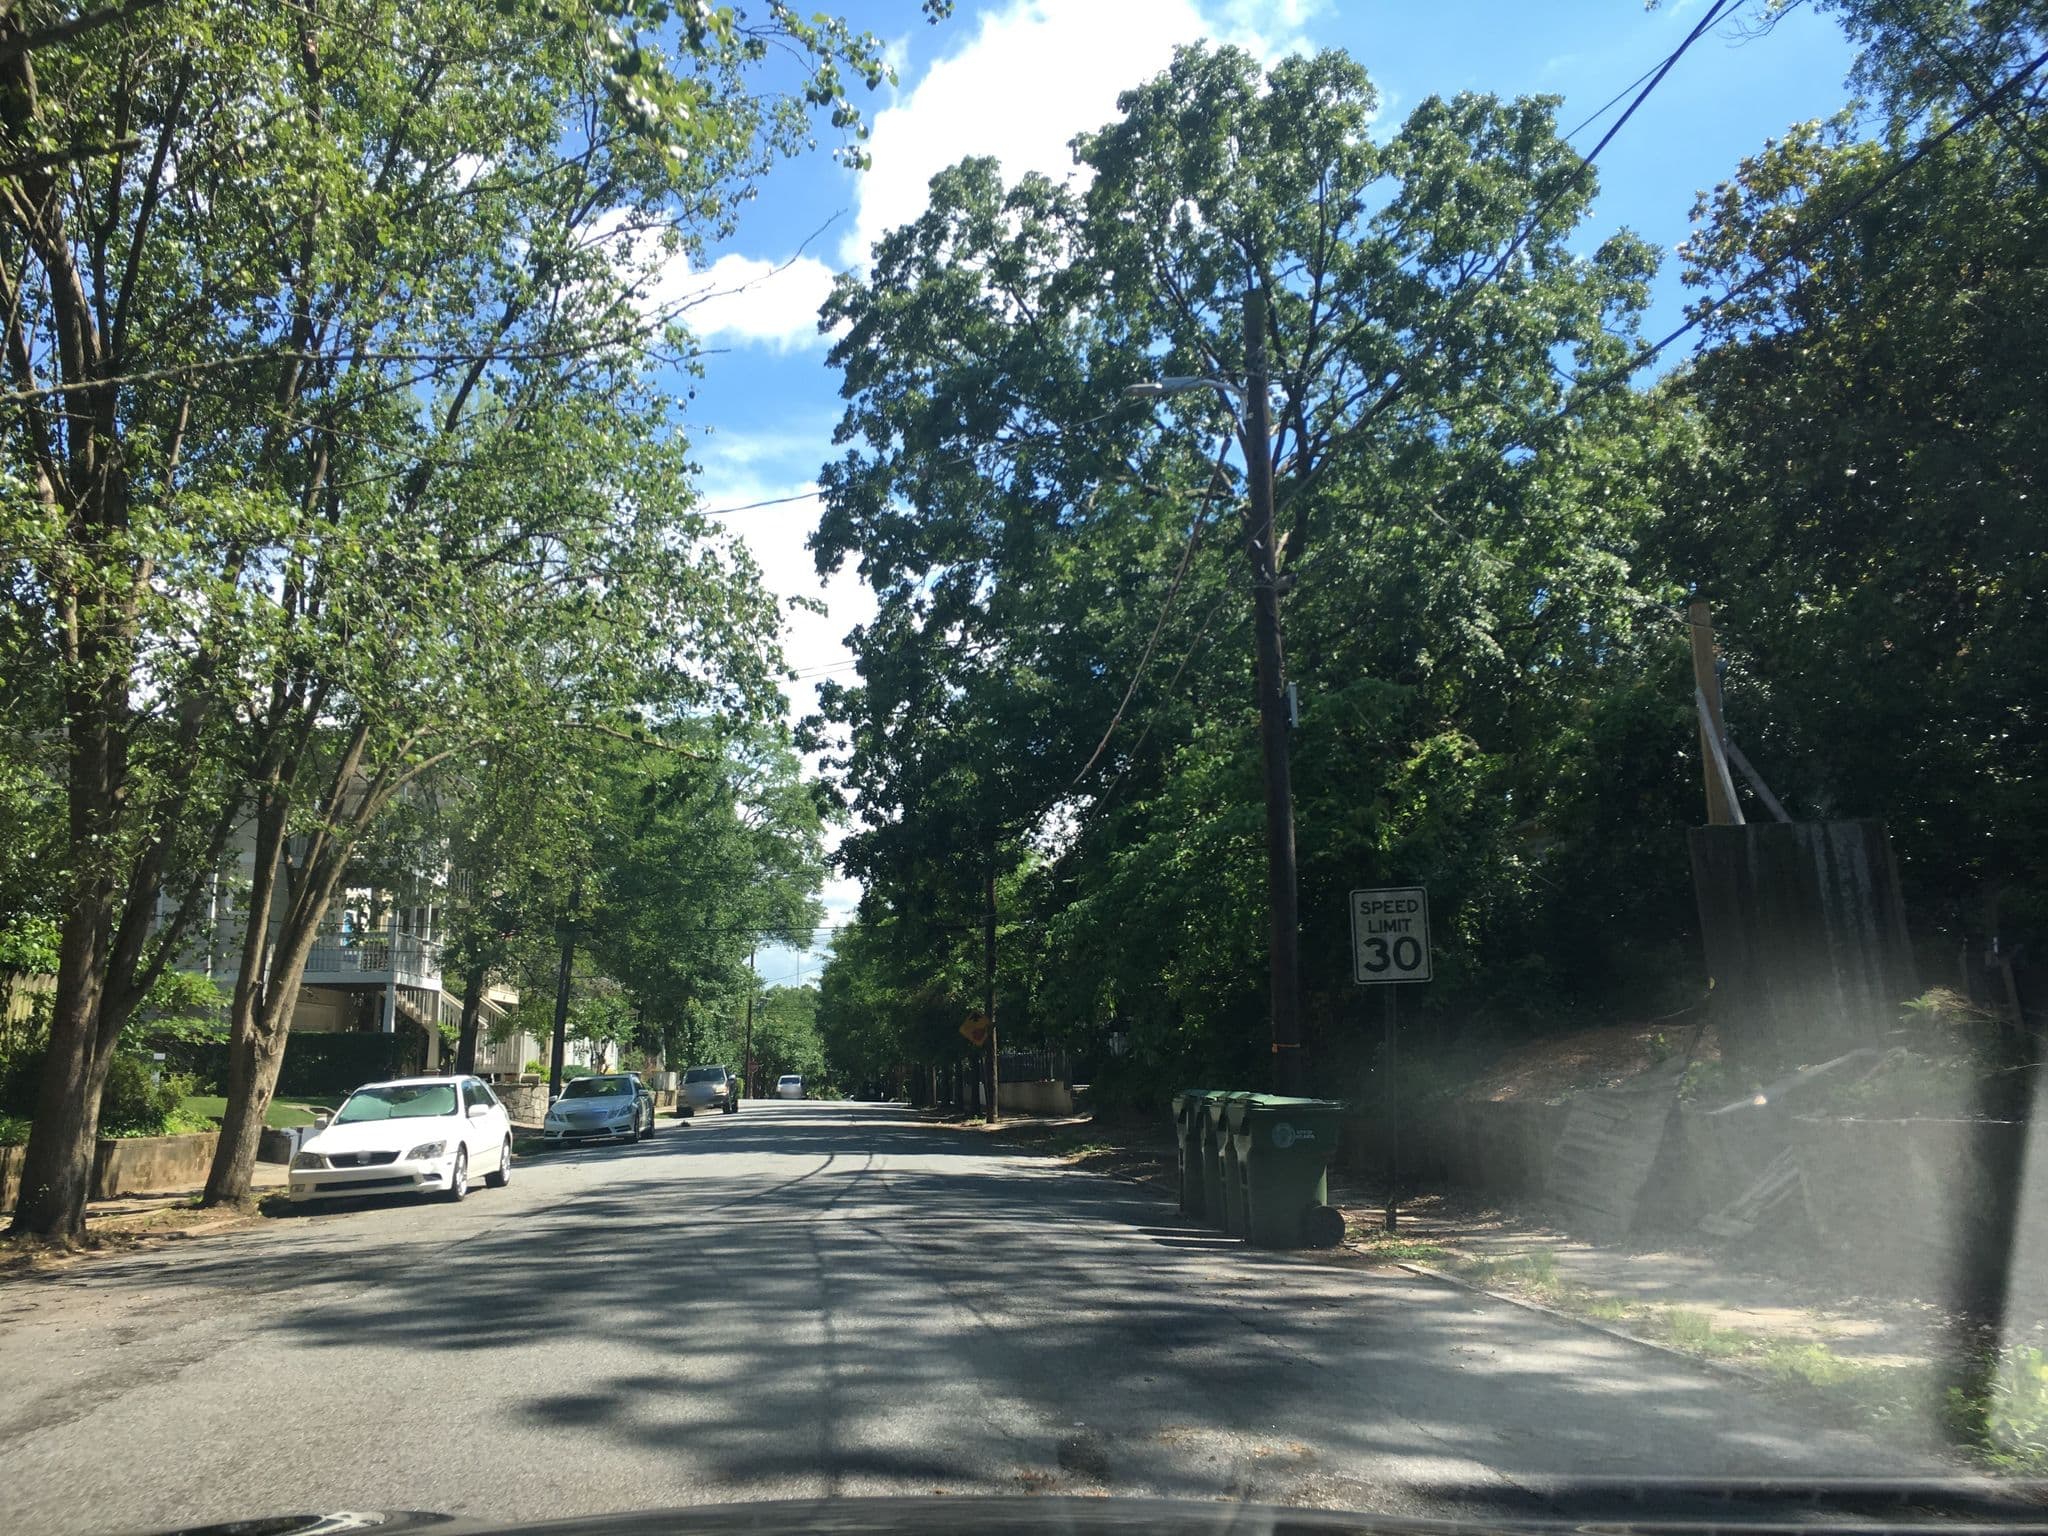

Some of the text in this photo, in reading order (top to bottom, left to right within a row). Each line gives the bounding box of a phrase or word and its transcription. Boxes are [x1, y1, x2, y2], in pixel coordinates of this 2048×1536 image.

[1360, 900, 1418, 914] SPEED
[1368, 919, 1412, 933] LIMIT
[1363, 937, 1422, 972] 30
